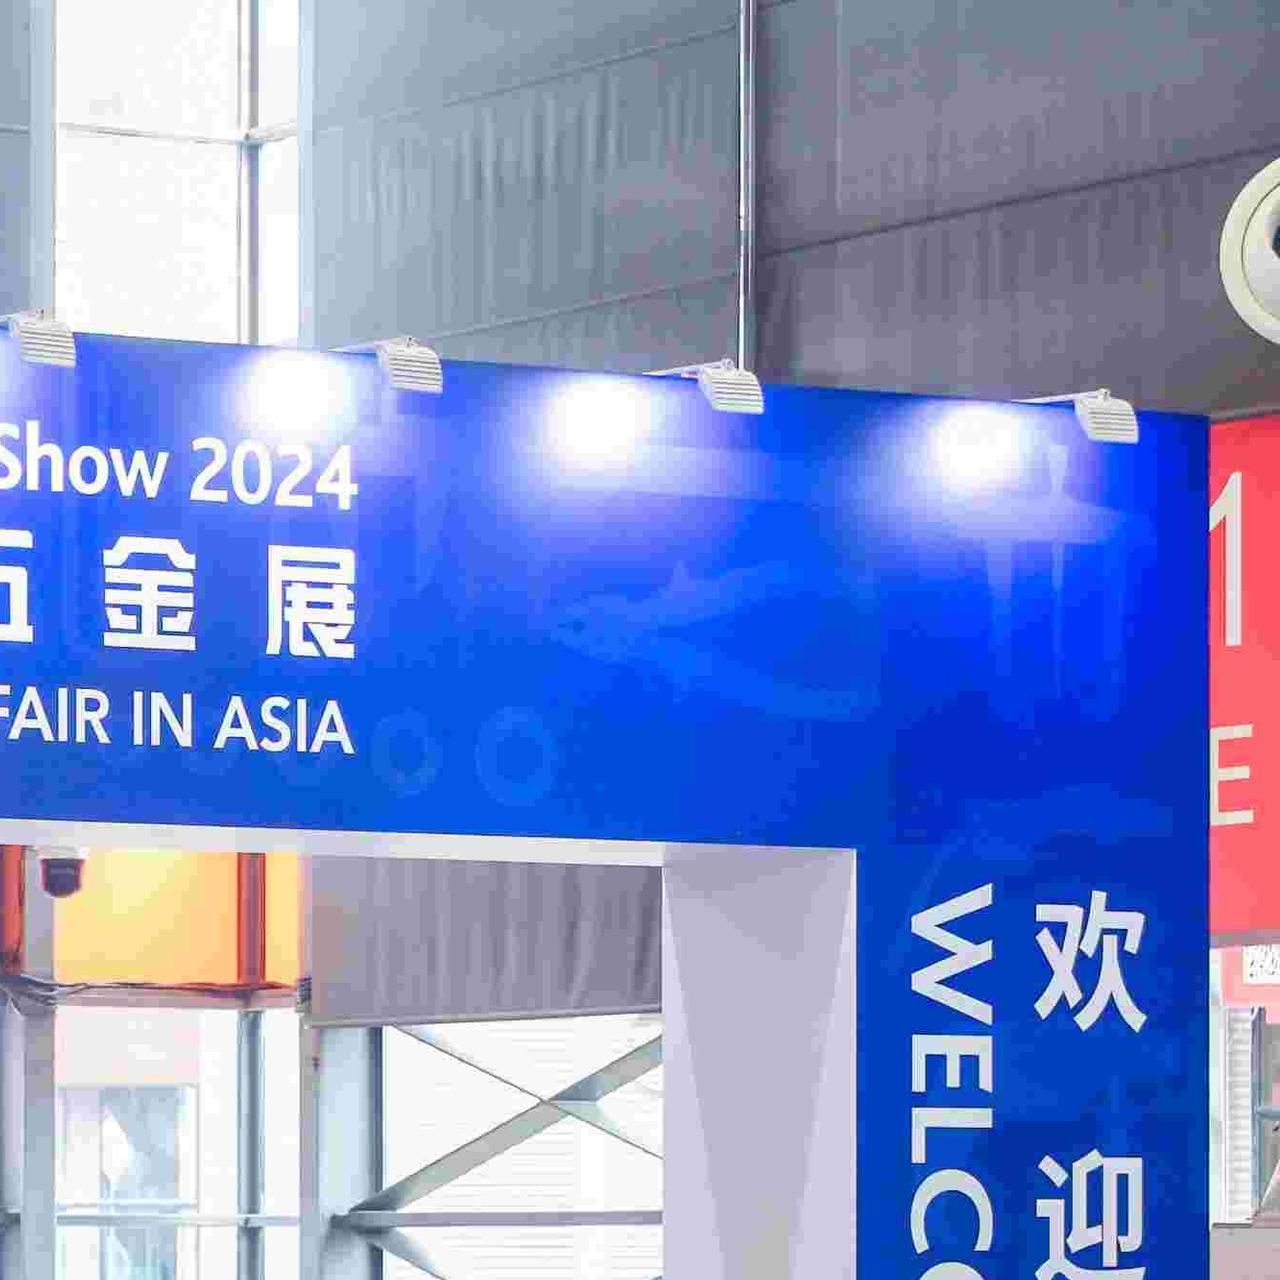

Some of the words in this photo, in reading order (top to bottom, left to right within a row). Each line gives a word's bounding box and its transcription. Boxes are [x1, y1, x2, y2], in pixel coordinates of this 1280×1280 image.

[189, 436, 359, 511] 2024
[133, 690, 193, 748] IN
[214, 695, 355, 755] ASIA
